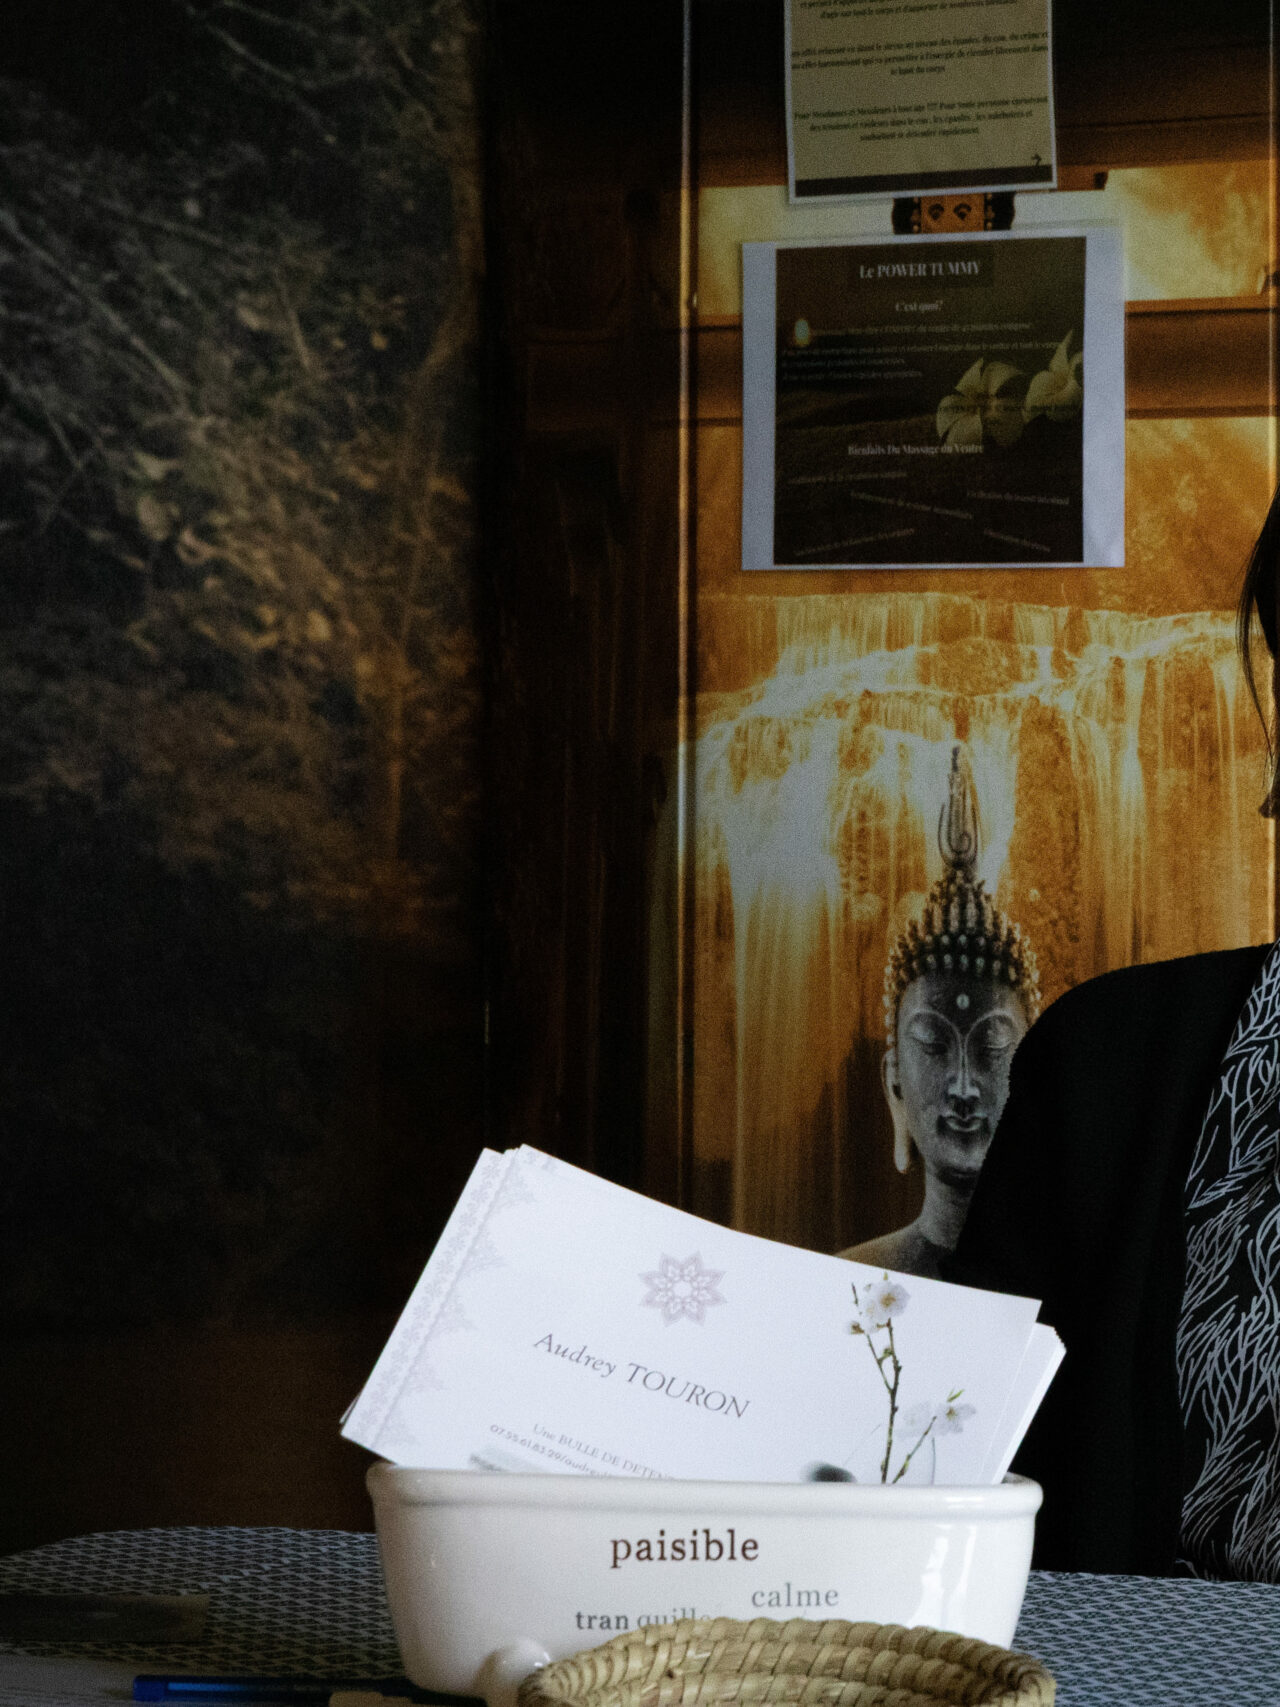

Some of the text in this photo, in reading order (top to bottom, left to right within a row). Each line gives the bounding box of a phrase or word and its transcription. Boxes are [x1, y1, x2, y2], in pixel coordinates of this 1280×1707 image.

[859, 260, 981, 278] Le POWER TUMMY
[533, 1333, 751, 1418] Audrey TOURON
[533, 1423, 556, 1440] Une
[558, 1434, 599, 1458] BULLE
[601, 1452, 620, 1465] DE
[610, 1528, 760, 1568] paisible
[751, 1582, 839, 1607] calme
